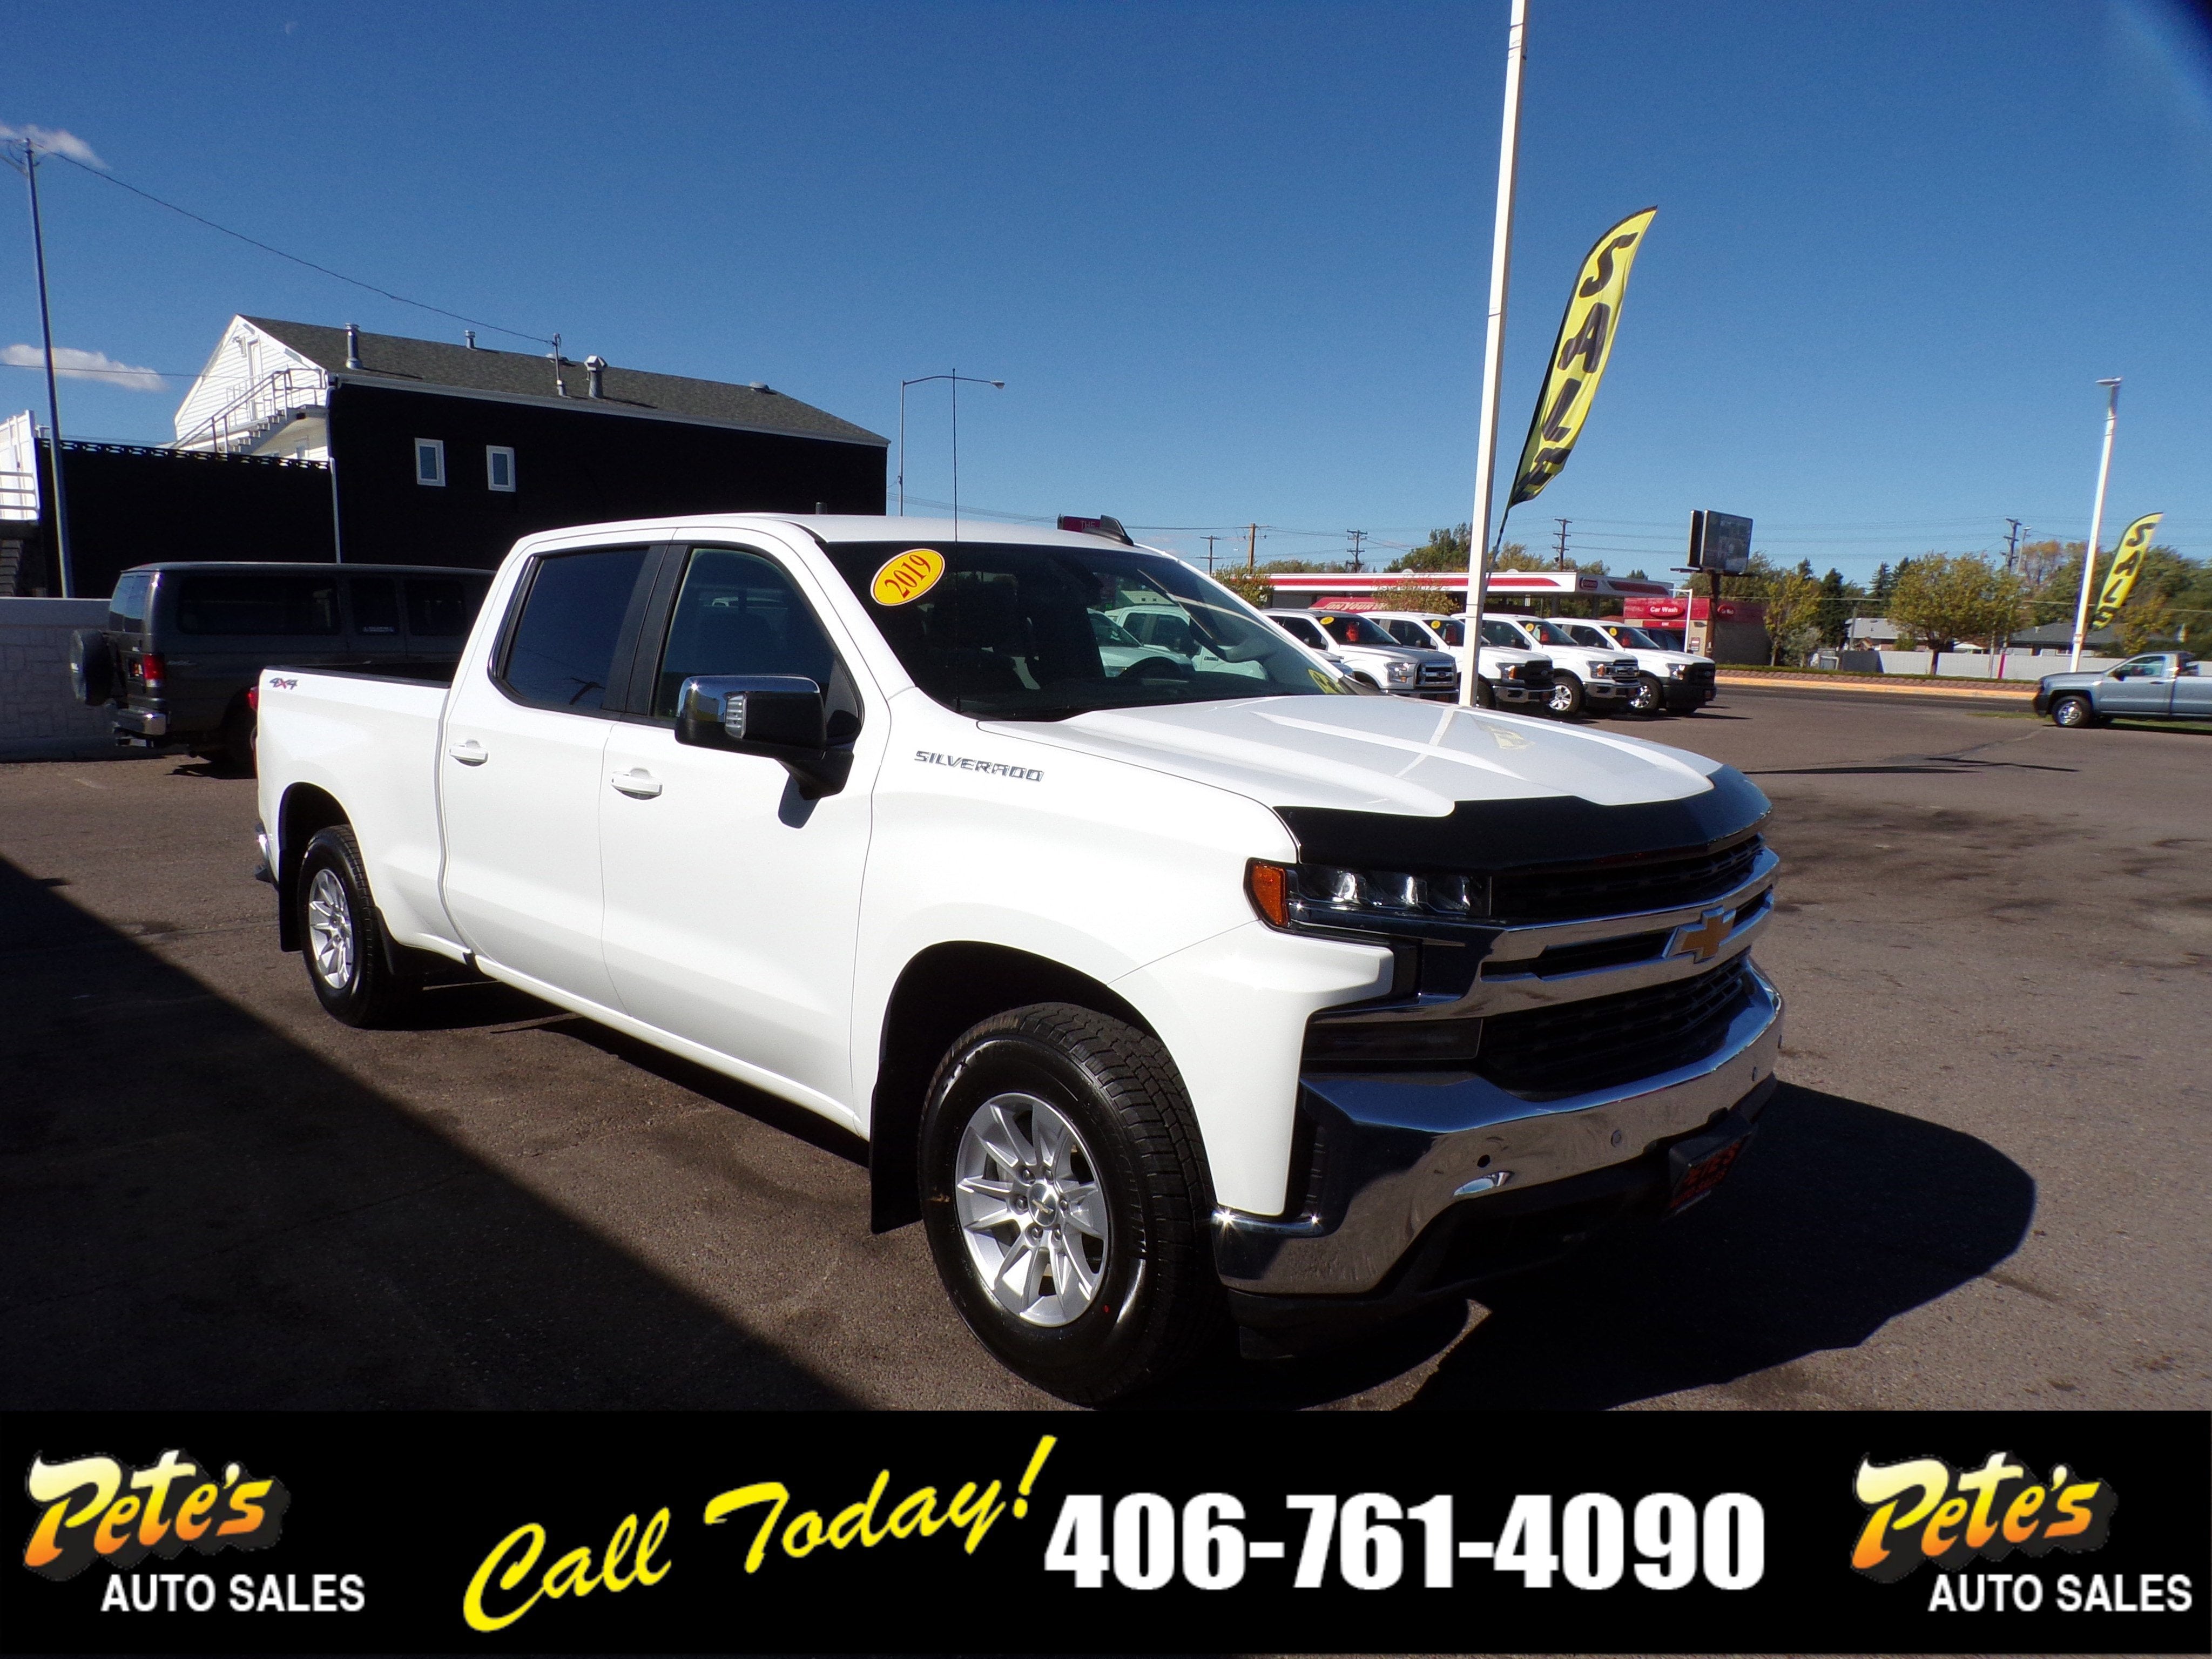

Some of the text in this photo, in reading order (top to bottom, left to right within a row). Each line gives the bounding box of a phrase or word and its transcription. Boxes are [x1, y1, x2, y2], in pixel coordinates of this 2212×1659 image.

[1512, 232, 1639, 505] SALE
[884, 554, 931, 599] 2019
[914, 750, 1044, 782] SILVERADO
